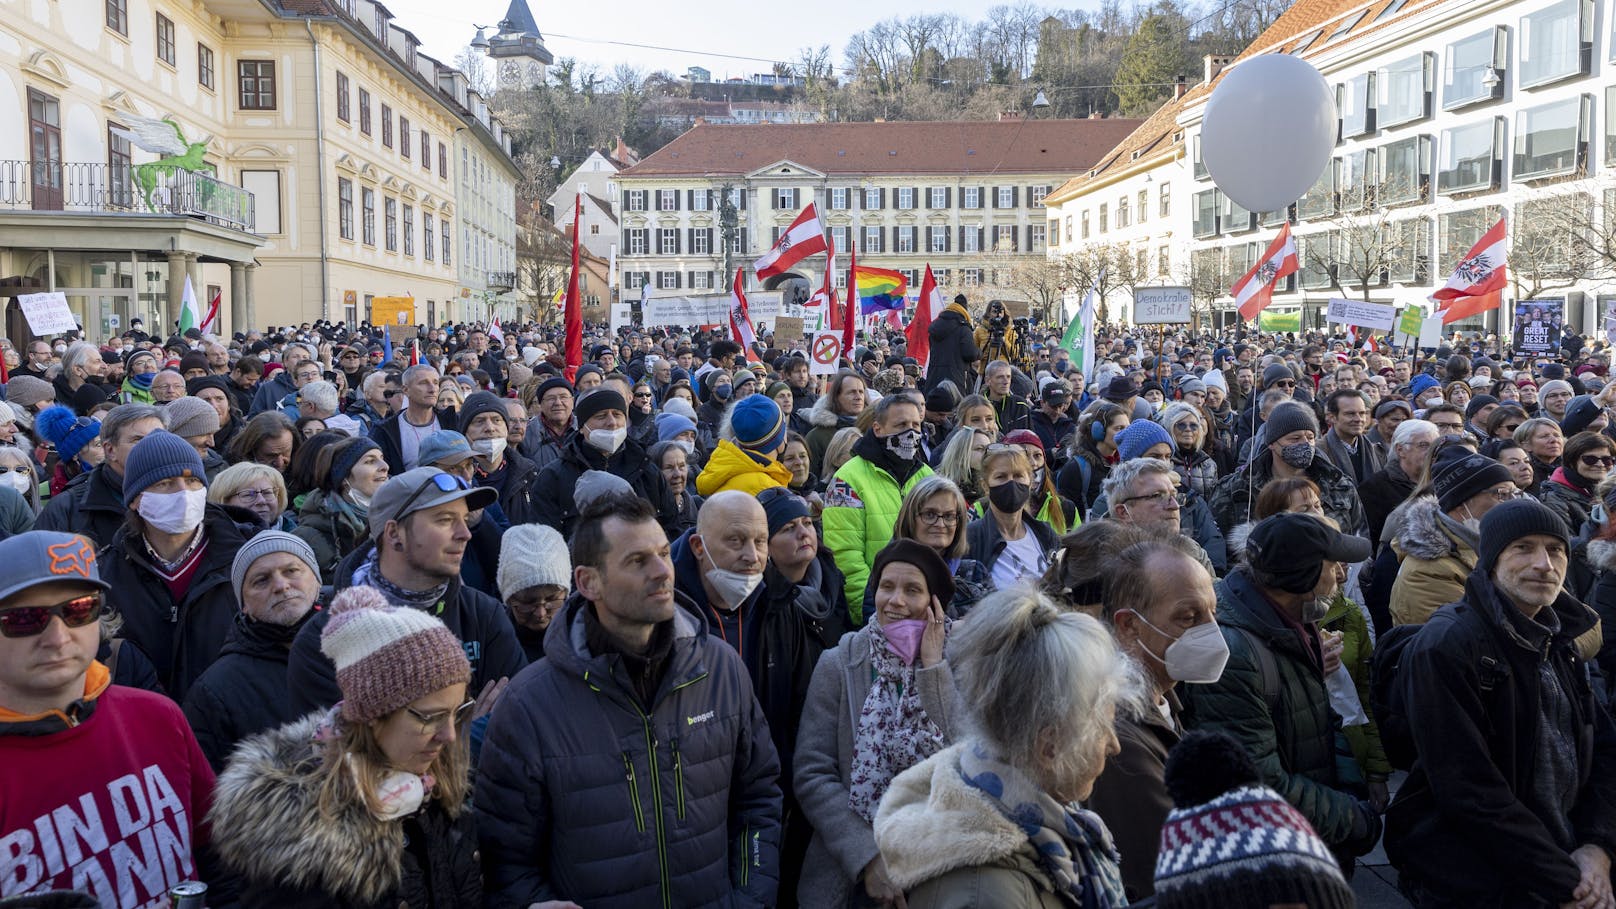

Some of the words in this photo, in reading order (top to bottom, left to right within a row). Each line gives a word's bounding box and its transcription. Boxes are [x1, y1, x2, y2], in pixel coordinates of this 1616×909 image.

[1136, 291, 1188, 304] Demokratie
[1146, 303, 1182, 316] sticht!
[1524, 326, 1549, 335] GREAT
[1523, 335, 1548, 344] RESET
[687, 710, 714, 726] benger
[0, 792, 110, 900] BIN
[107, 764, 185, 839] DA
[34, 810, 193, 909] ANN
